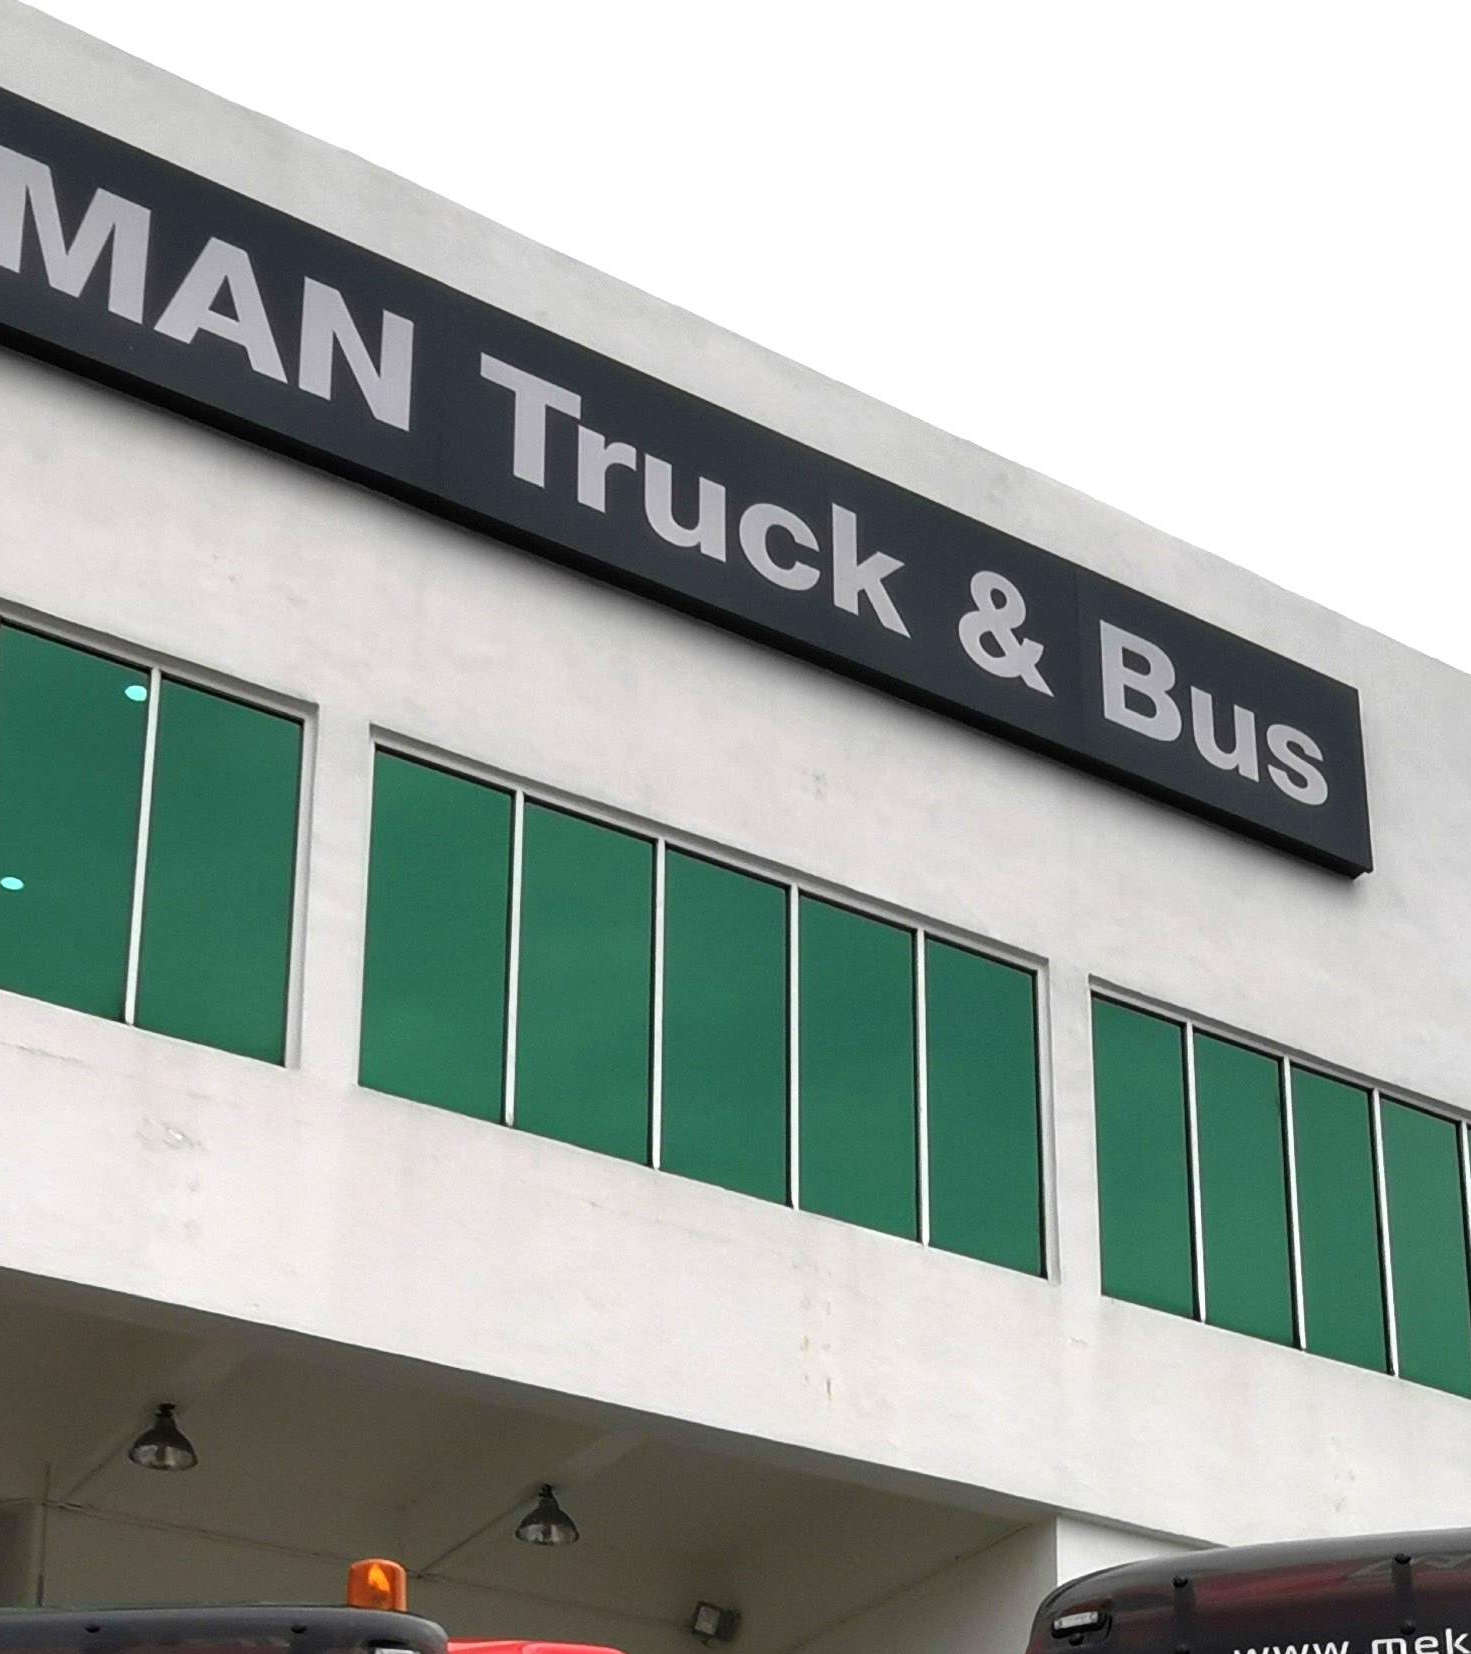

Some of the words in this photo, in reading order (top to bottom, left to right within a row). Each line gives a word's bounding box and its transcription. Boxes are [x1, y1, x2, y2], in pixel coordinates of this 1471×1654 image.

[481, 352, 910, 638] Truck
[957, 569, 1054, 697] &
[1098, 618, 1330, 808] Bus
